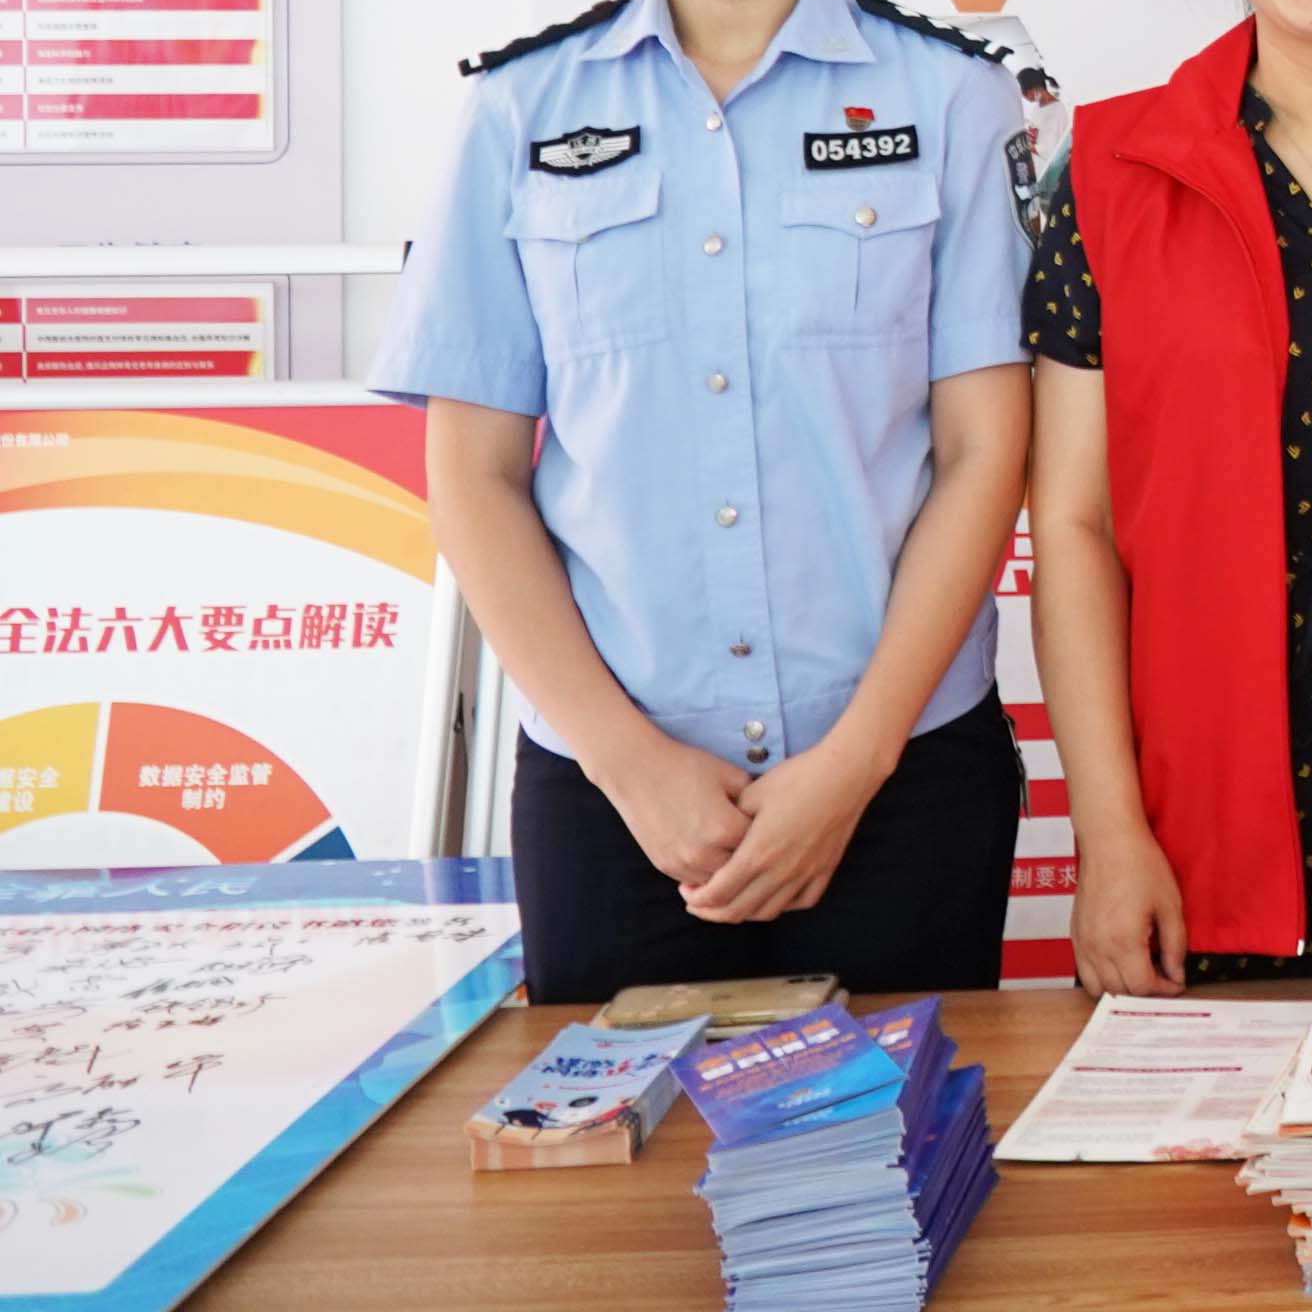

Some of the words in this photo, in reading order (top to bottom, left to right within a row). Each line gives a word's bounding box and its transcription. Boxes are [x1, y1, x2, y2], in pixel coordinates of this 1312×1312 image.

[810, 133, 911, 163] 054392
[0, 602, 400, 654] 全法六大要点解读
[138, 763, 273, 787] 数据安全监管
